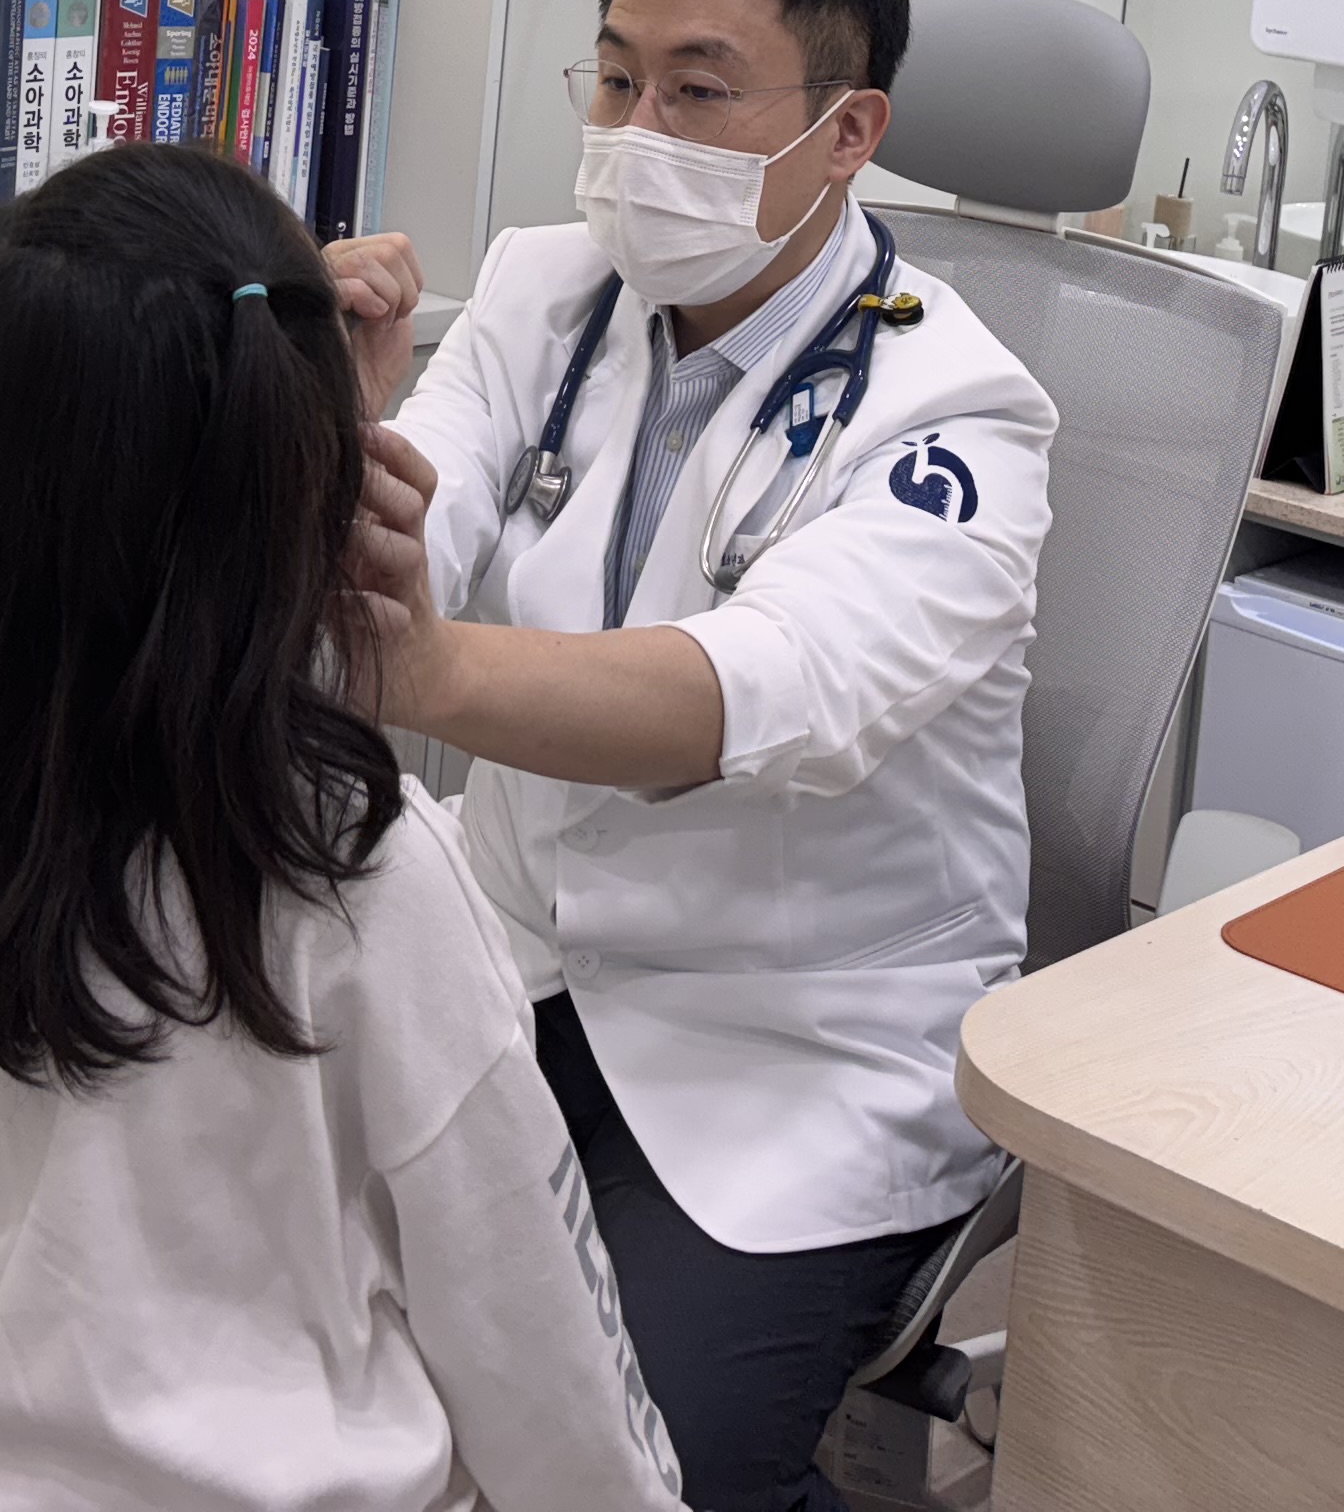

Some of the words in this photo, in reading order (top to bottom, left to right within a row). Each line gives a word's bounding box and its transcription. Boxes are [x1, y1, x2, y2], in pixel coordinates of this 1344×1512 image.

[166, 30, 192, 39] Sperling
[247, 29, 259, 60] 2024
[23, 63, 45, 153] 소아과학
[63, 61, 84, 149] 소아과학
[200, 32, 223, 138] 소아내분비학
[346, 52, 360, 109] 실시기준과
[134, 81, 149, 141] Williams
[344, 113, 356, 136] 방법
